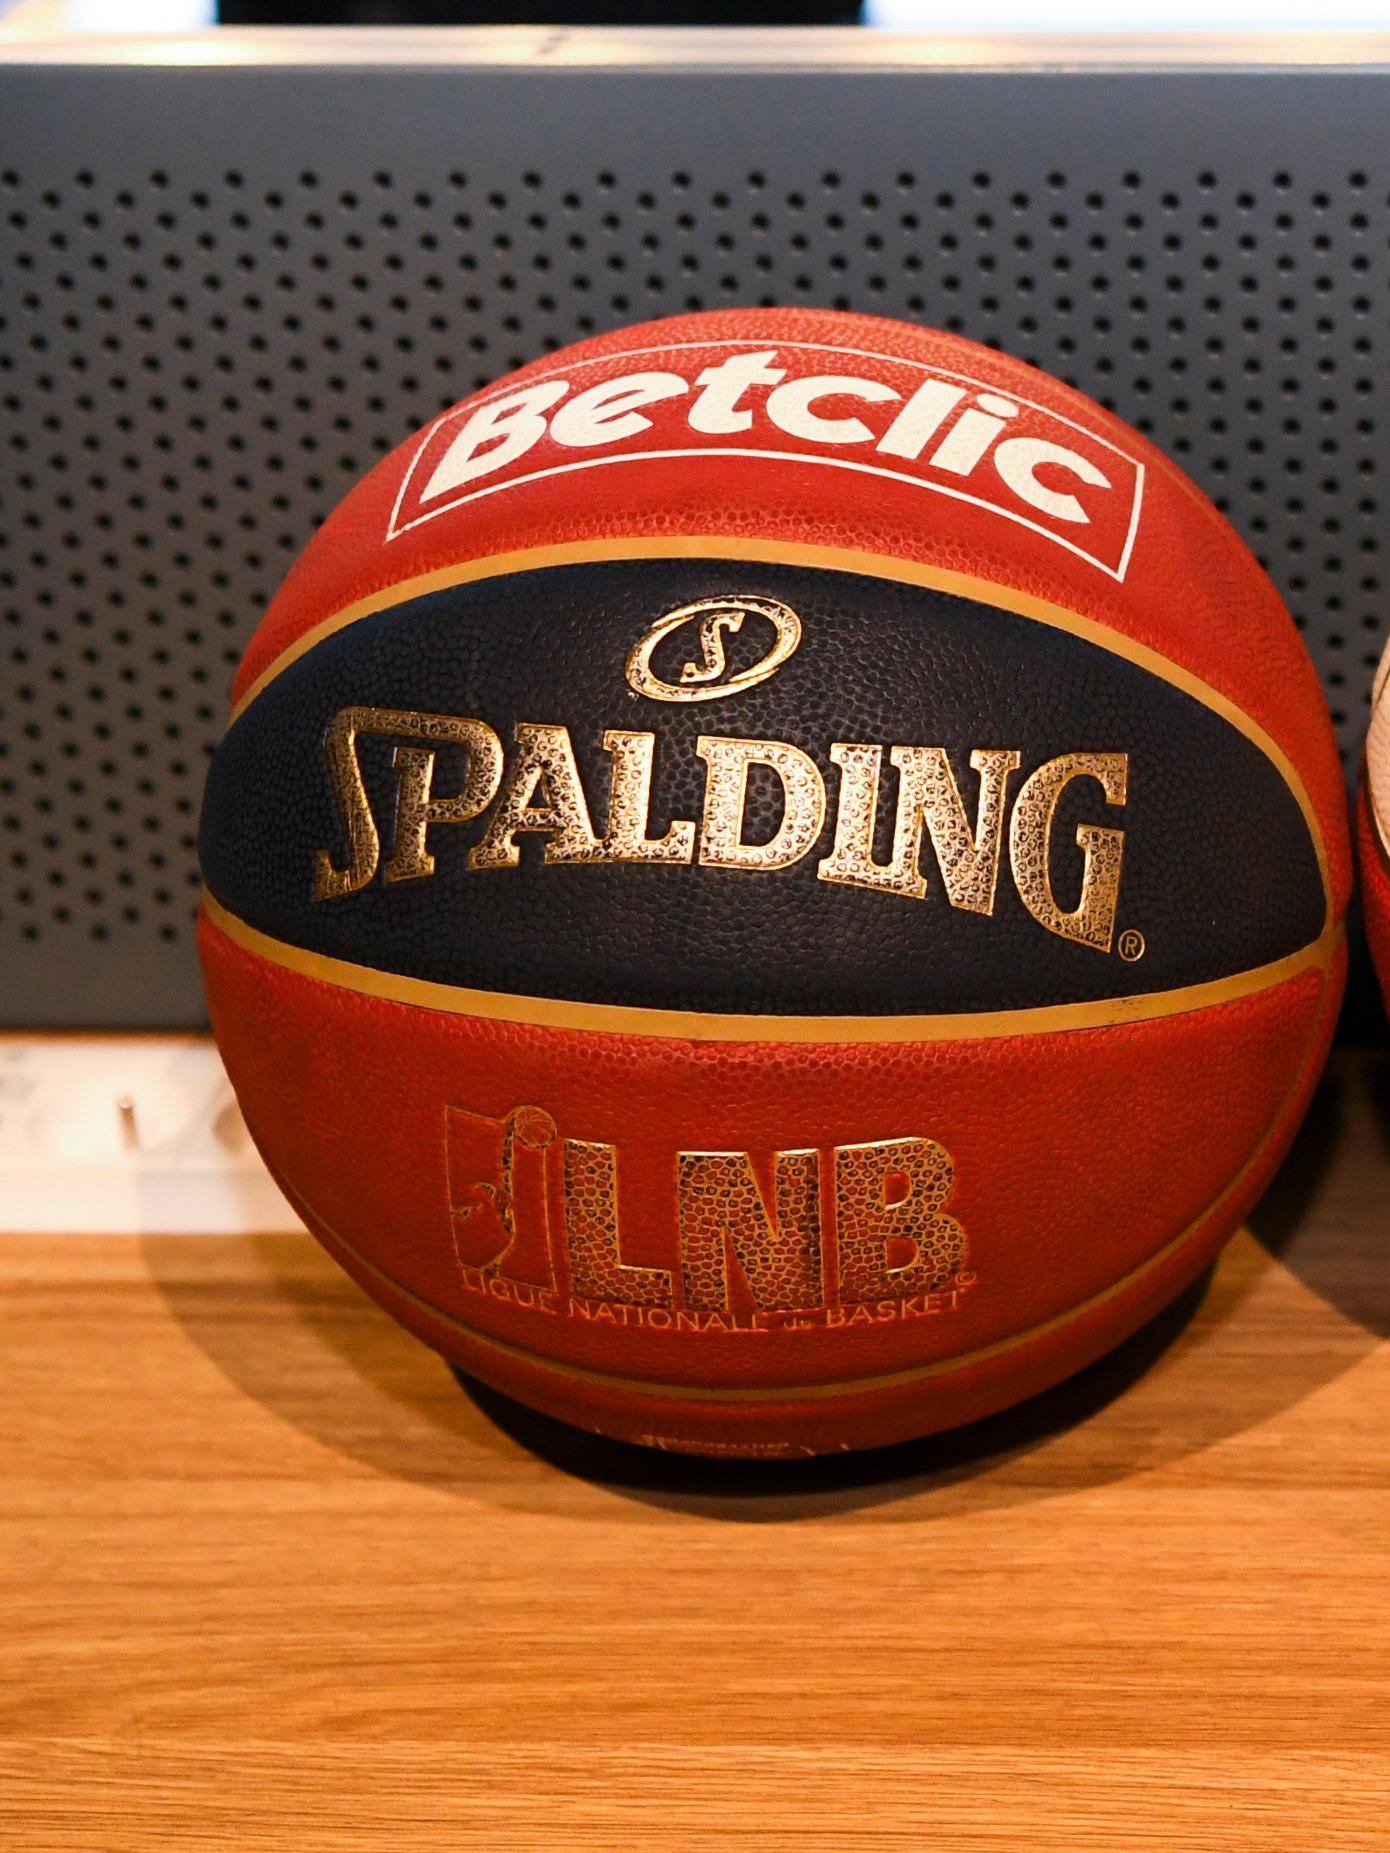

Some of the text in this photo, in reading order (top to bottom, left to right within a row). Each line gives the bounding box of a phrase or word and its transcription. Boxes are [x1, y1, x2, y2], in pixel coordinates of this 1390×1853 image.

[419, 350, 1112, 526] Betclic
[314, 704, 1128, 954] SPALDING
[462, 1268, 560, 1315] LIGUE
[568, 1298, 769, 1333] NATIONALE
[825, 1286, 967, 1329] BASKET
[562, 1136, 968, 1312] LNB
